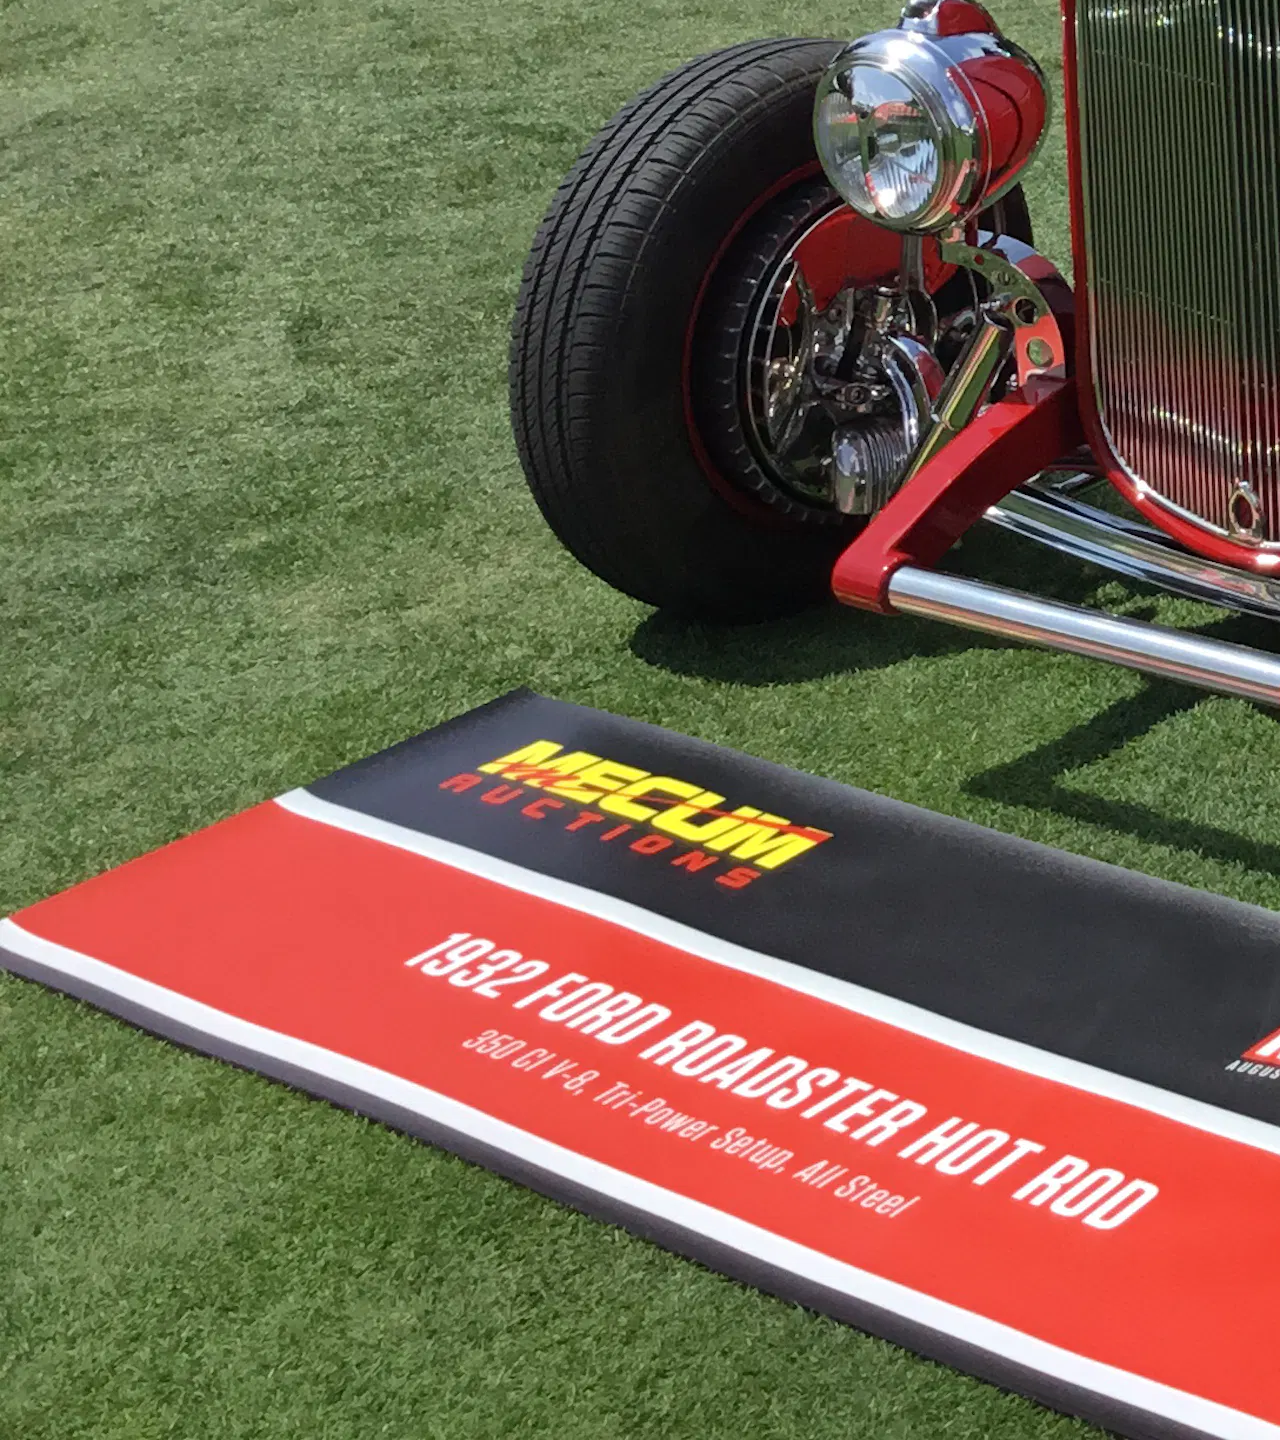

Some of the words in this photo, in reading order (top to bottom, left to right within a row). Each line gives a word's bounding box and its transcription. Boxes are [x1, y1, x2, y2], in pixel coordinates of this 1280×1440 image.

[438, 772, 761, 889] AUCTIONS
[477, 739, 833, 869] MECUM
[404, 932, 550, 998] 1932
[513, 972, 672, 1045] FORD
[639, 1020, 928, 1147] ROADSTER
[898, 1116, 1046, 1187] HOT
[1011, 1154, 1160, 1230] ROD
[462, 1029, 528, 1060] 350
[511, 1047, 551, 1072] CI
[541, 1061, 600, 1096] V-8,
[593, 1081, 717, 1141] Tri-Power
[711, 1126, 794, 1174] Setup,
[792, 1159, 848, 1189] All
[835, 1175, 921, 1218] Steel
